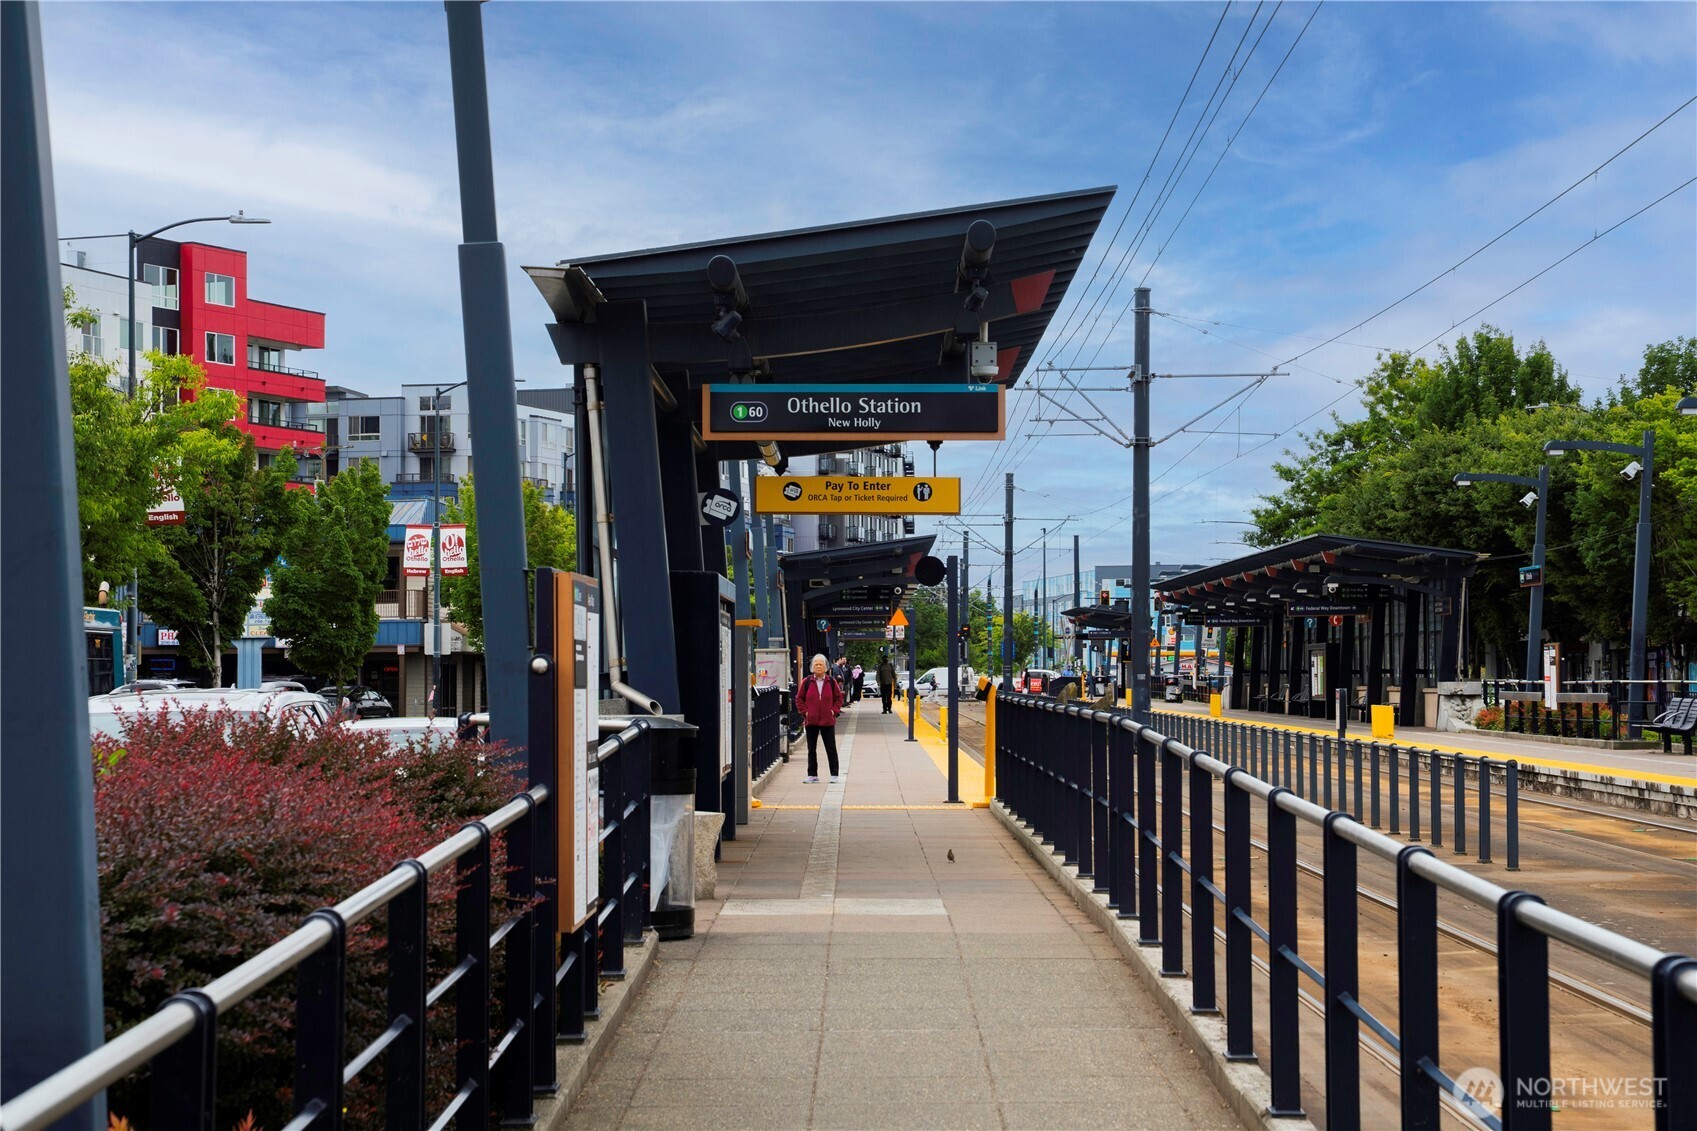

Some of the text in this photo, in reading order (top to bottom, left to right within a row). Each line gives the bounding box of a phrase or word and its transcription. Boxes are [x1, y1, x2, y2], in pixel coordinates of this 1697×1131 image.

[787, 397, 922, 414] Othello Station
[737, 407, 763, 417] 1 60
[828, 417, 881, 429] New Holly
[825, 481, 891, 493] Pay To Enter
[808, 494, 828, 502] ORCA
[830, 494, 843, 503] Tap
[854, 494, 875, 502] Ticket
[876, 494, 908, 503] Required
[715, 502, 732, 513] orca
[148, 513, 179, 521] English
[409, 546, 428, 556] hello
[444, 546, 464, 556] hello
